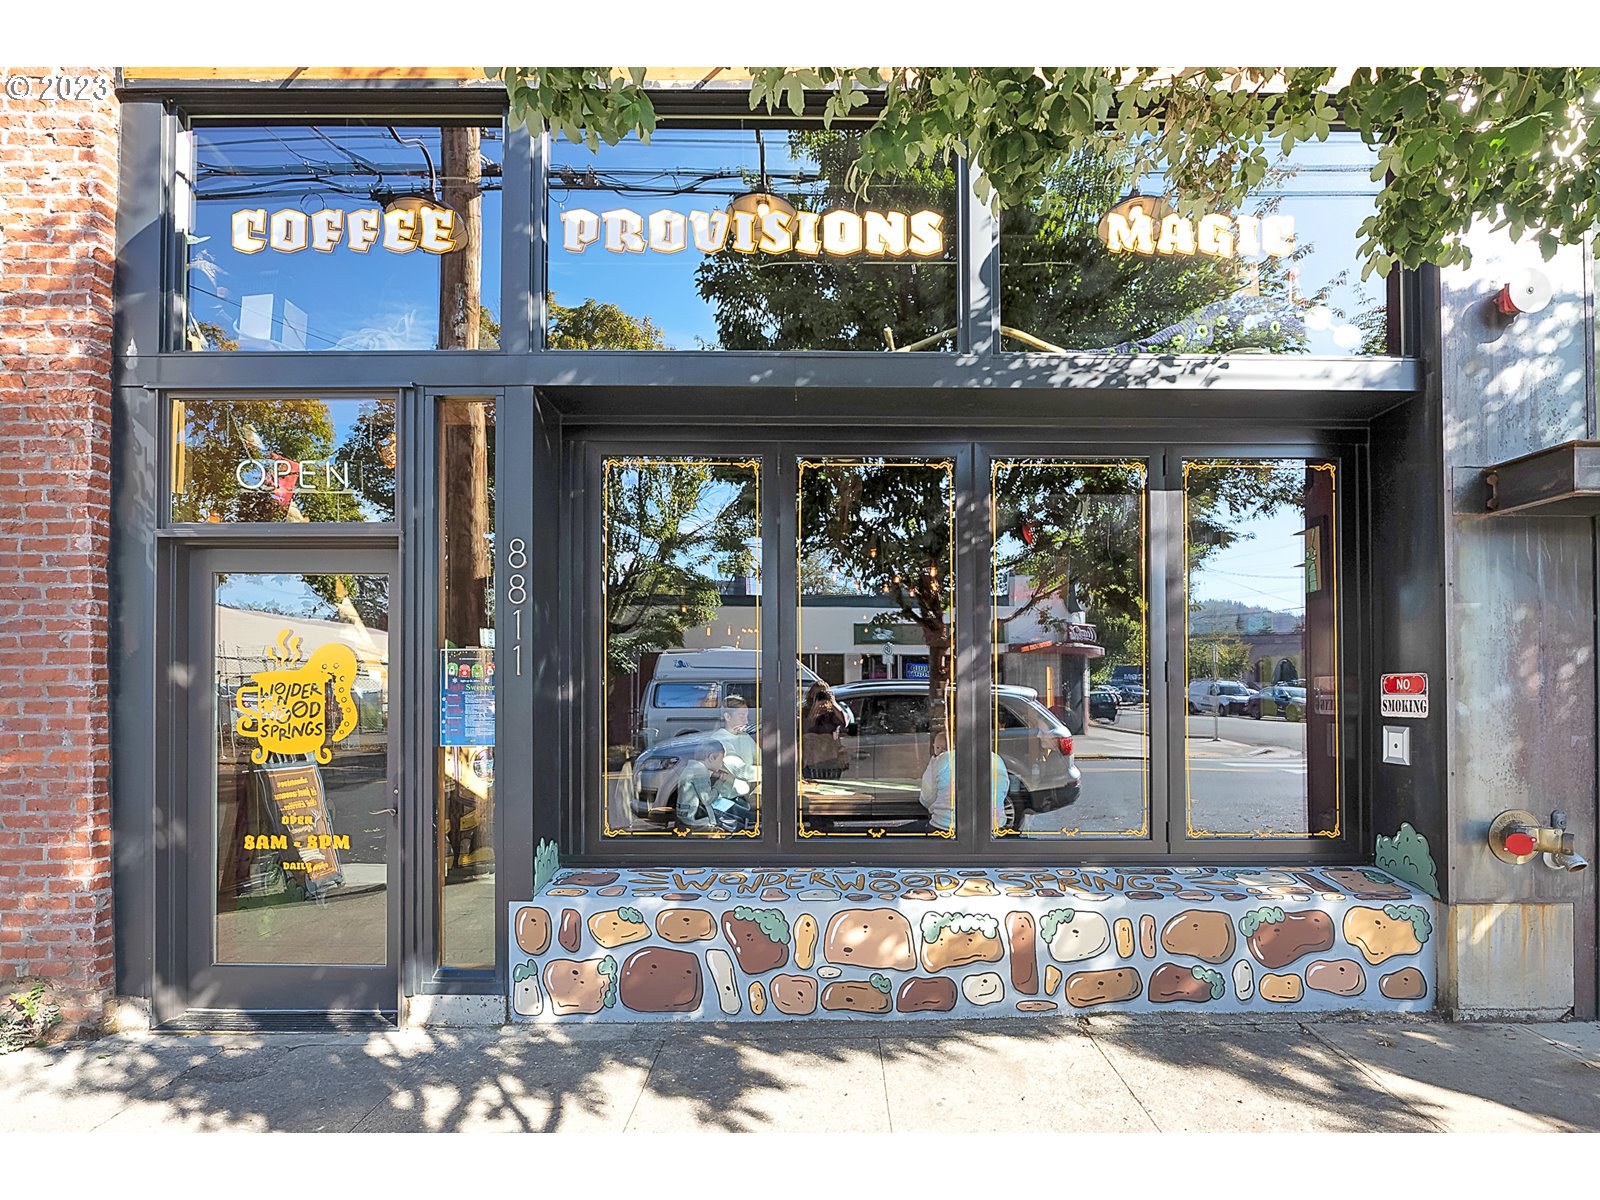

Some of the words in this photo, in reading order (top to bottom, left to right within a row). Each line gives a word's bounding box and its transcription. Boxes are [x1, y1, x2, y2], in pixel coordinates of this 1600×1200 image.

[231, 208, 457, 254] COFFEE
[560, 208, 945, 257] PROVISIONS
[1106, 211, 1296, 259] MAGIC
[236, 460, 350, 489] OPEN
[508, 538, 527, 676] 8811
[260, 682, 322, 706] WONDER
[1396, 678, 1411, 690] NO
[261, 700, 321, 724] WOOD
[1382, 699, 1427, 713] SMOKING
[260, 720, 323, 742] SPRINGS
[281, 815, 313, 825] OPEN
[244, 834, 288, 850] 8AM
[307, 834, 350, 850] 8PM
[283, 862, 312, 873] DAILY
[998, 873, 1183, 893] SPRINGS
